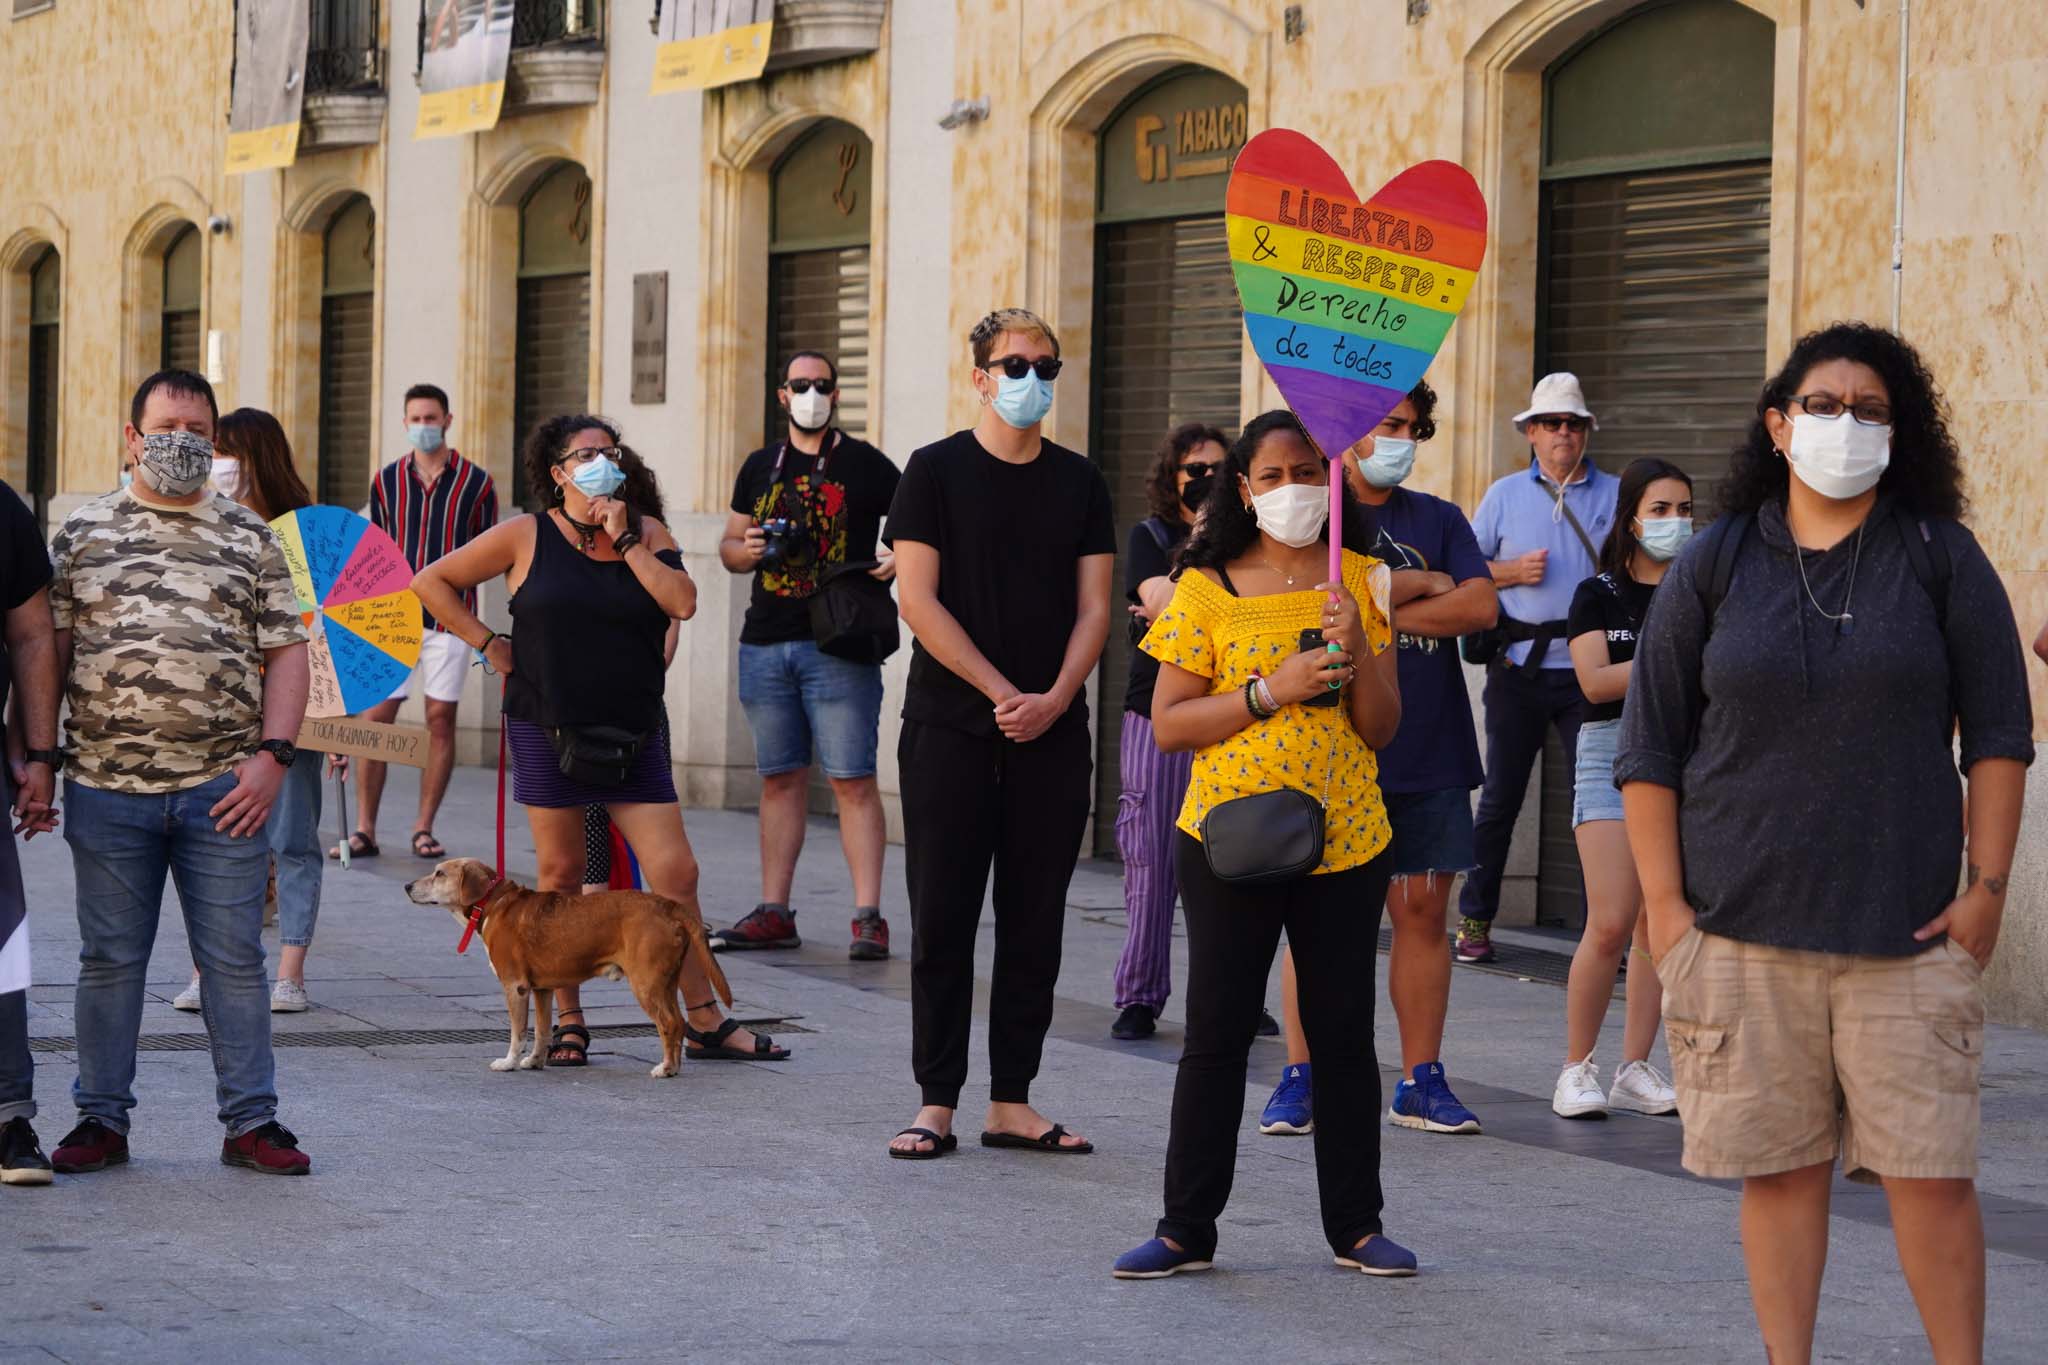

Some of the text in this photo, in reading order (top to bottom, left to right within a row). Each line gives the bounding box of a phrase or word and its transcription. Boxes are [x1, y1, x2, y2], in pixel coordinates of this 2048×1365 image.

[1252, 226, 1277, 261] &
[1276, 276, 1407, 331] Derecho
[1276, 325, 1392, 380] de todes
[312, 721, 334, 740] TOCA
[336, 726, 383, 749] AGUANTAR
